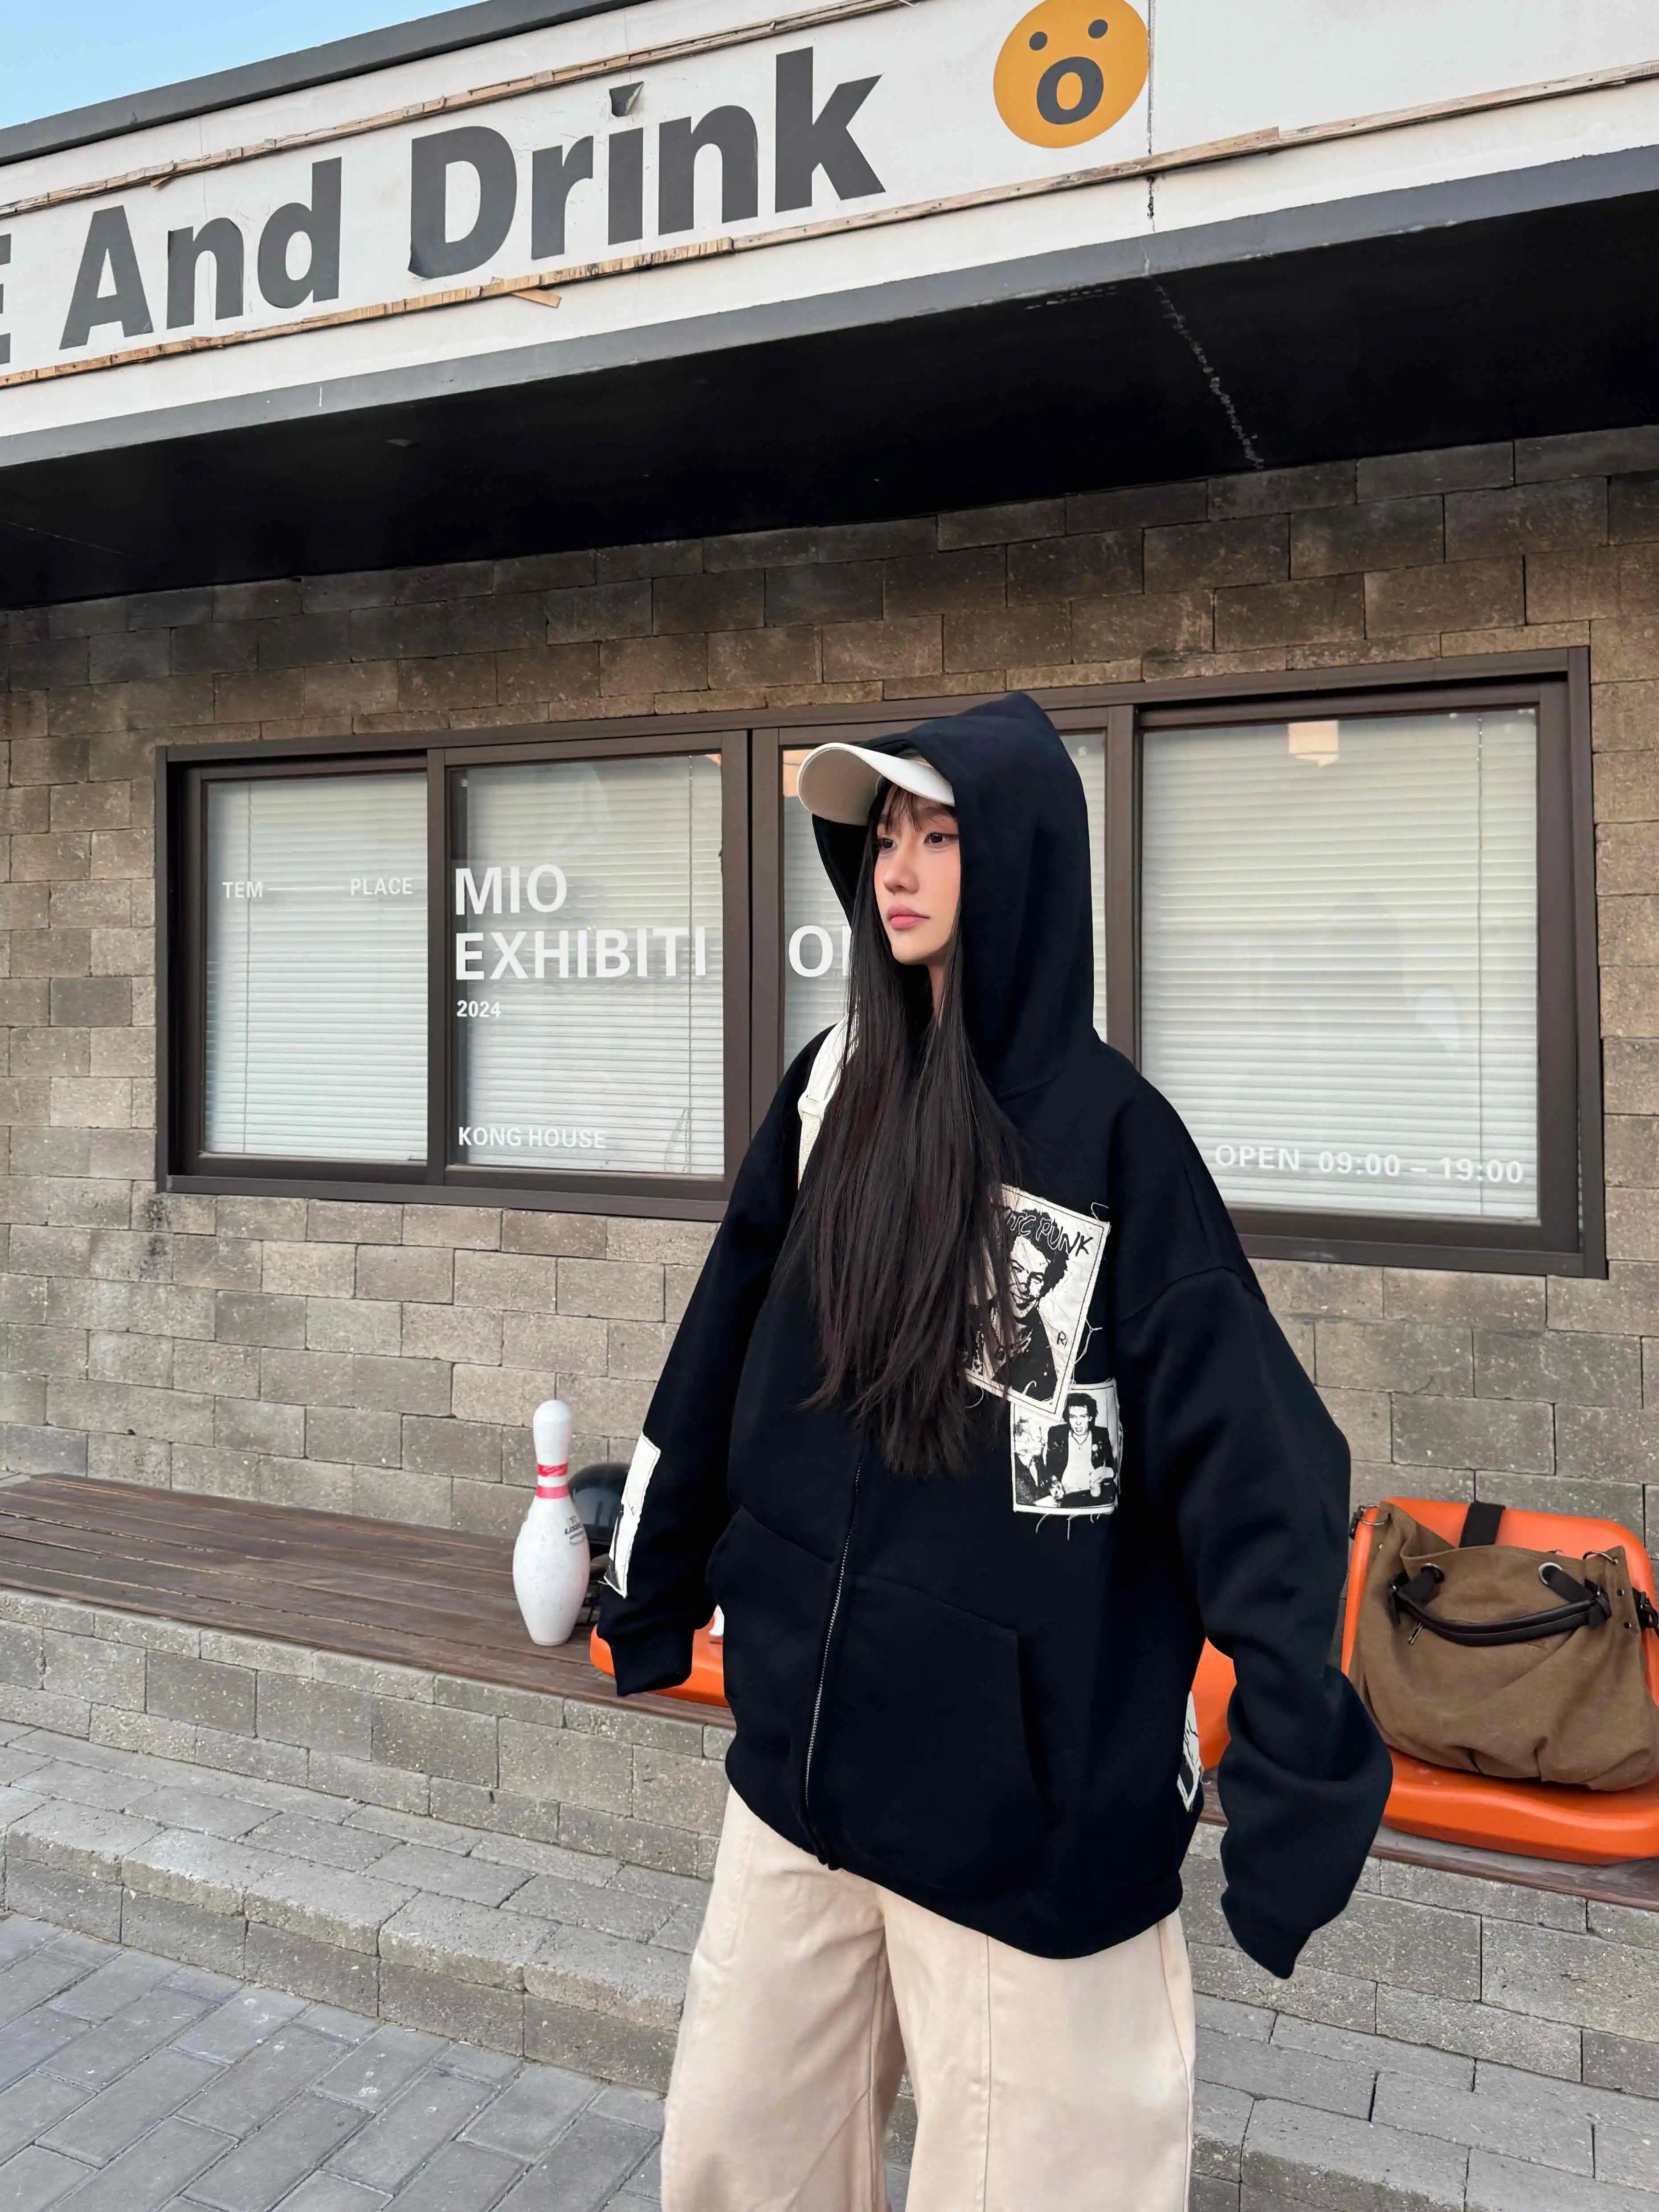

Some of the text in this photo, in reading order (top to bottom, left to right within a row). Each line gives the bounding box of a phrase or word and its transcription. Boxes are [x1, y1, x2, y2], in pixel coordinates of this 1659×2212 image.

[59, 157, 342, 350] And
[408, 46, 886, 279] Drink
[223, 877, 413, 898] TEM PLACE
[455, 864, 567, 915] MIO
[455, 924, 852, 980] EXHIBITI O
[456, 1000, 502, 1018] 2024
[458, 1127, 606, 1149] KONG HOUSE
[1215, 1145, 1299, 1171] OPEN
[1318, 1151, 1400, 1177] 09:00
[1439, 1157, 1523, 1183] 19:00
[1035, 1217, 1094, 1257] PUNK
